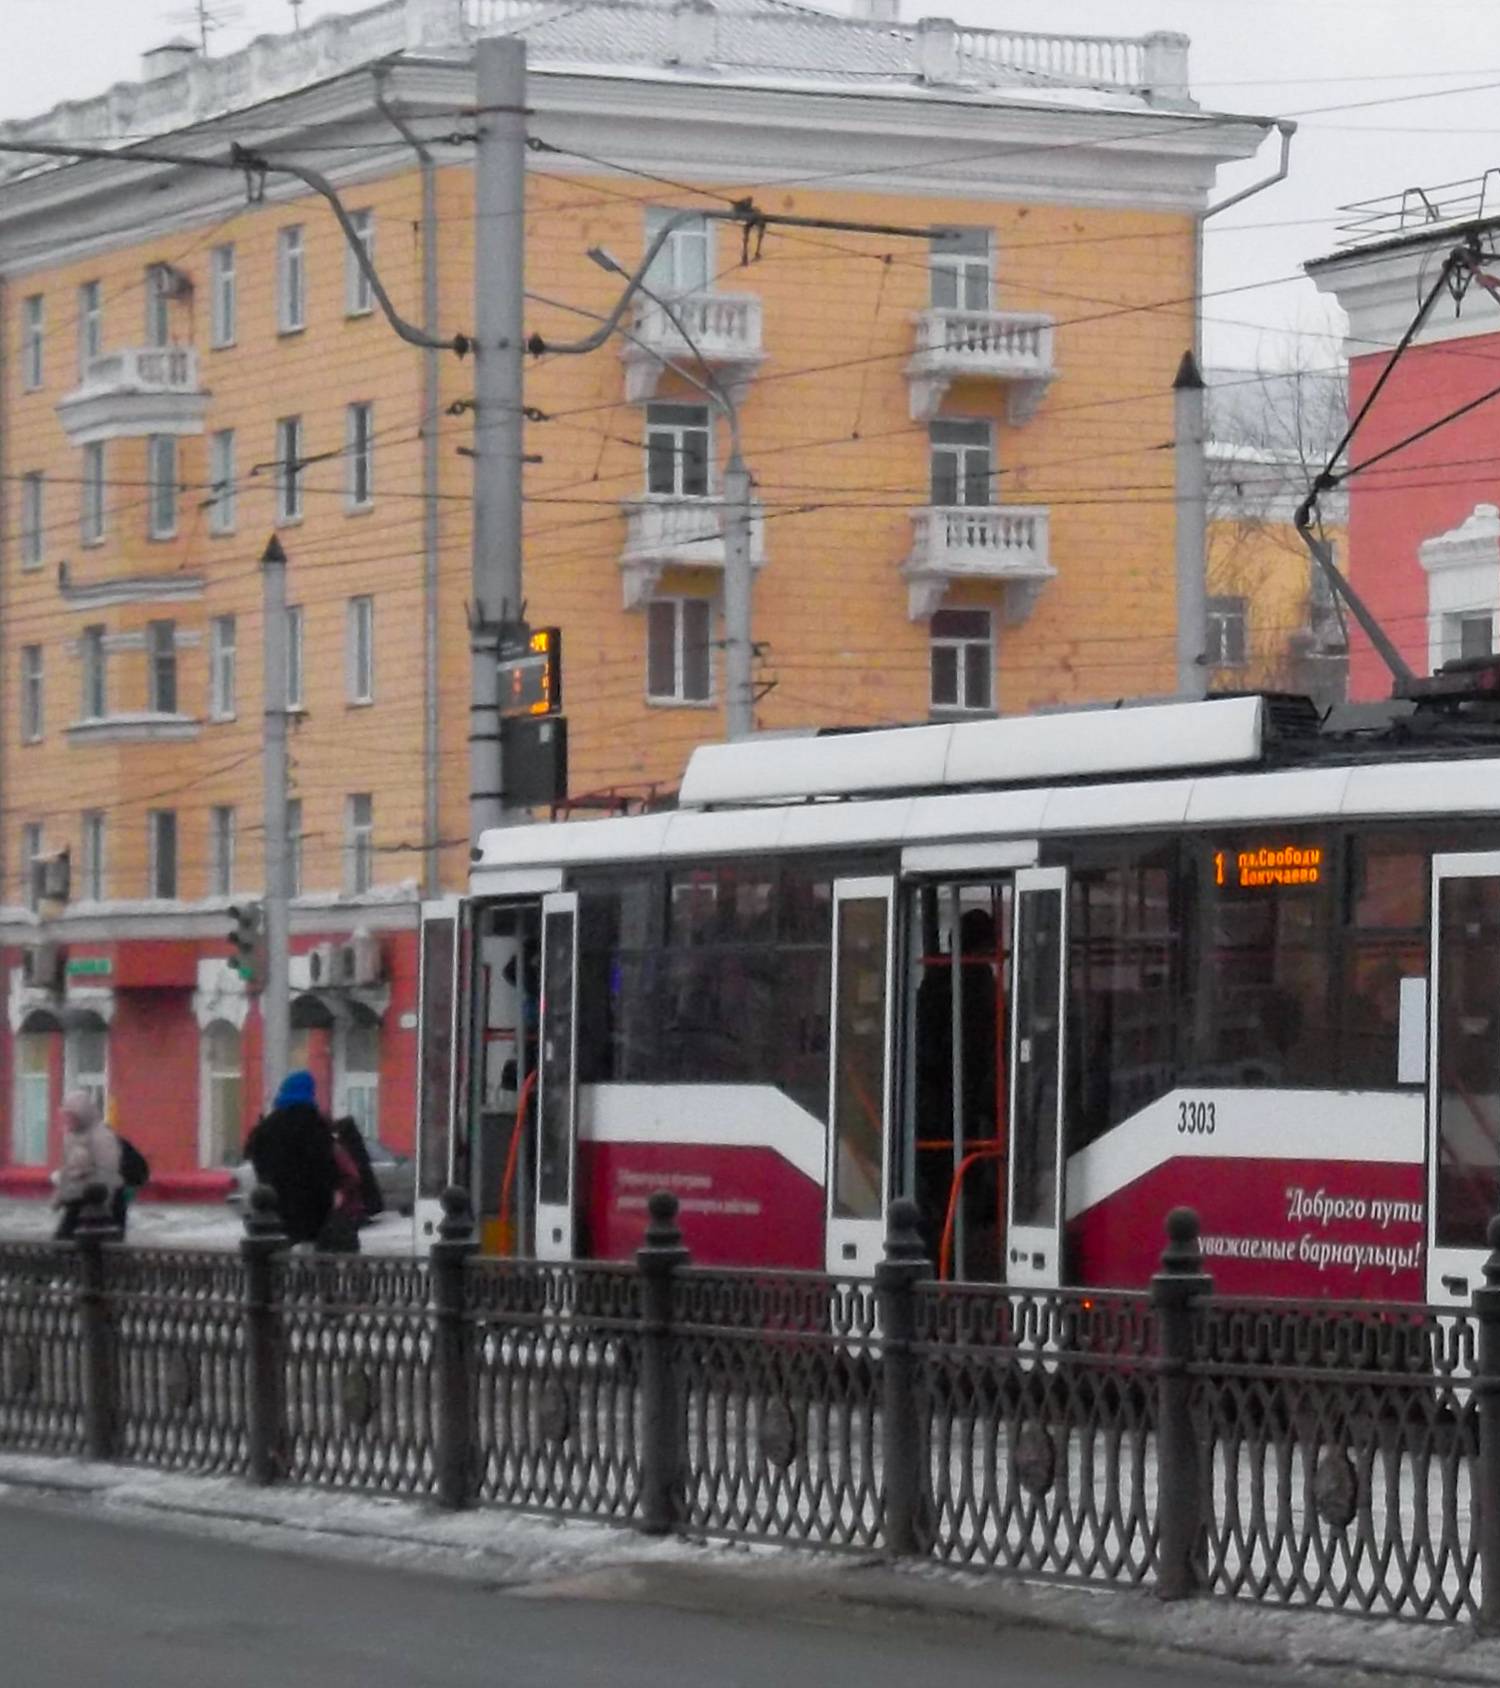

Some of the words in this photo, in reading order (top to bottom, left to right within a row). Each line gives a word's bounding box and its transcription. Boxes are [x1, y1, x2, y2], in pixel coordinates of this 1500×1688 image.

[1215, 852, 1224, 885] 1
[1177, 1101, 1215, 1134] 3303
[1370, 1202, 1424, 1229] пути
[1198, 1236, 1296, 1261] уважаемые
[1299, 1233, 1422, 1276] барнаульцы!
